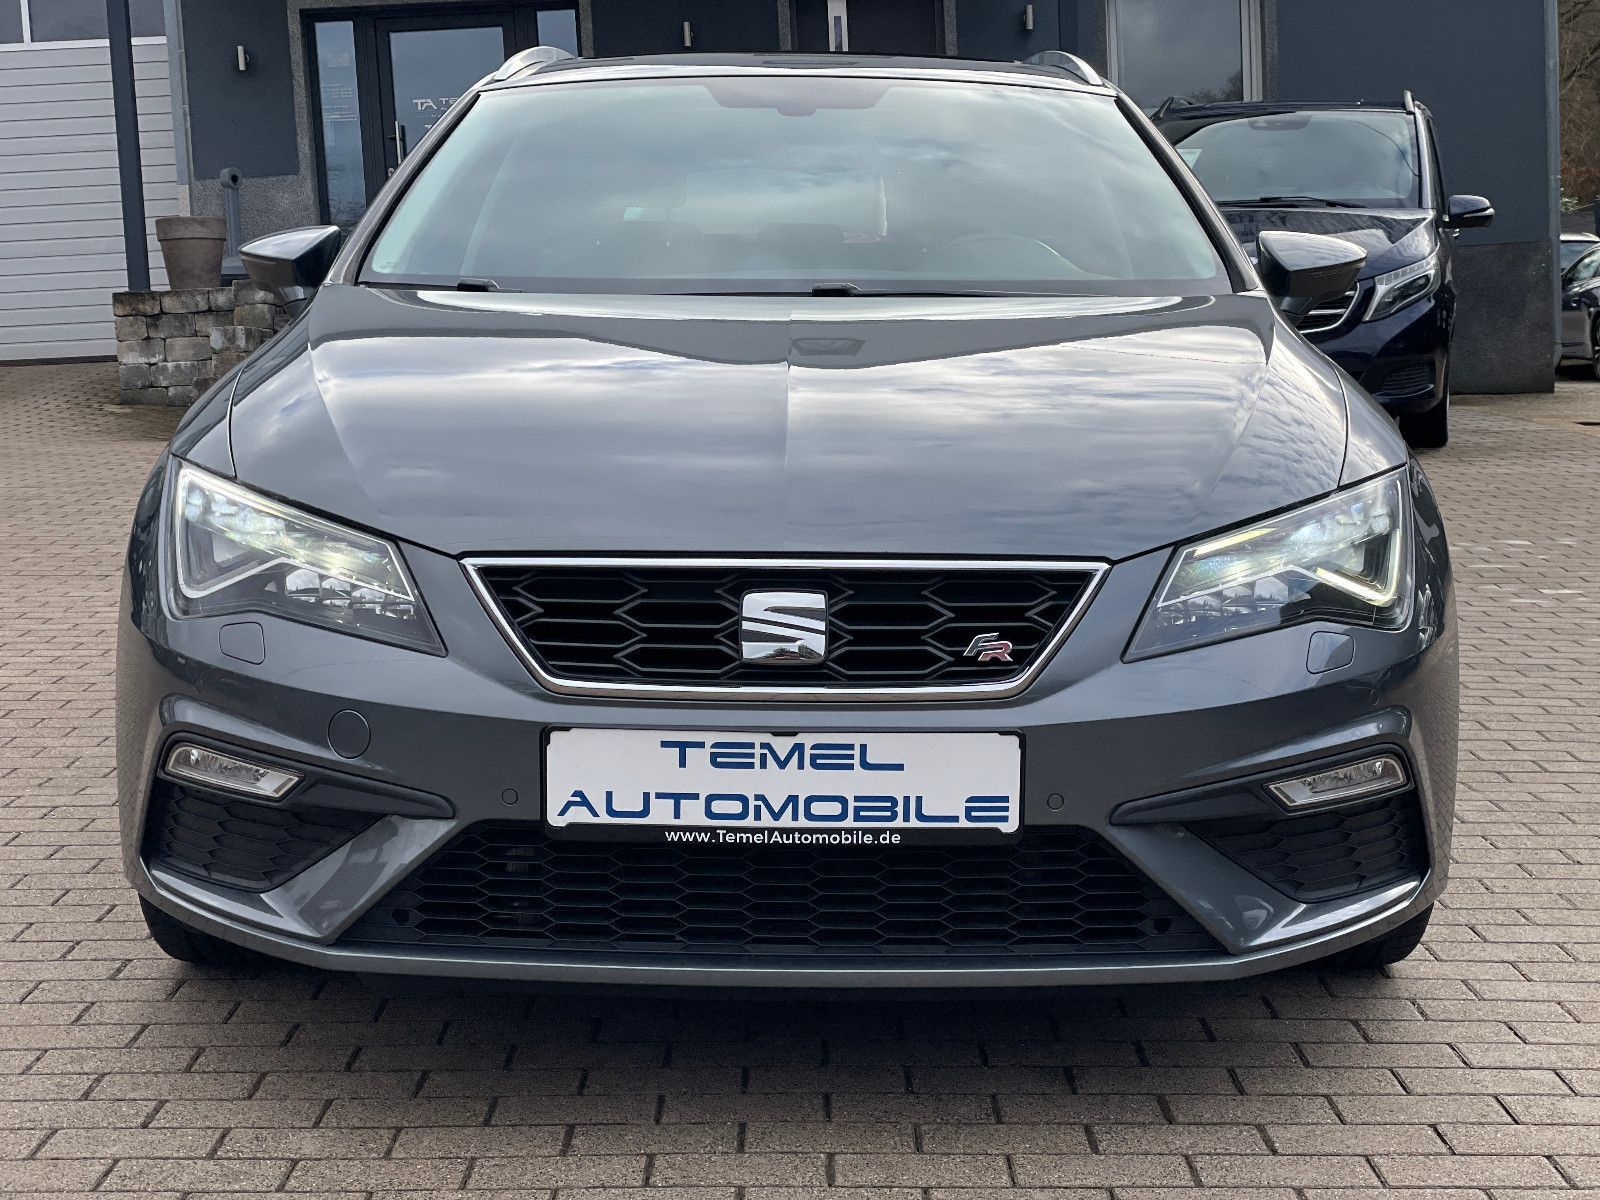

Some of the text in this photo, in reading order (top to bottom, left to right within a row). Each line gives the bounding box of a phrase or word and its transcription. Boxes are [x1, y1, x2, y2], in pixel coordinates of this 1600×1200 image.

[963, 632, 1013, 661] FR
[660, 740, 905, 772] TEMEL
[556, 789, 1010, 824] AUTOMOBILE
[664, 828, 902, 845] www.TemelAutomobile.de
